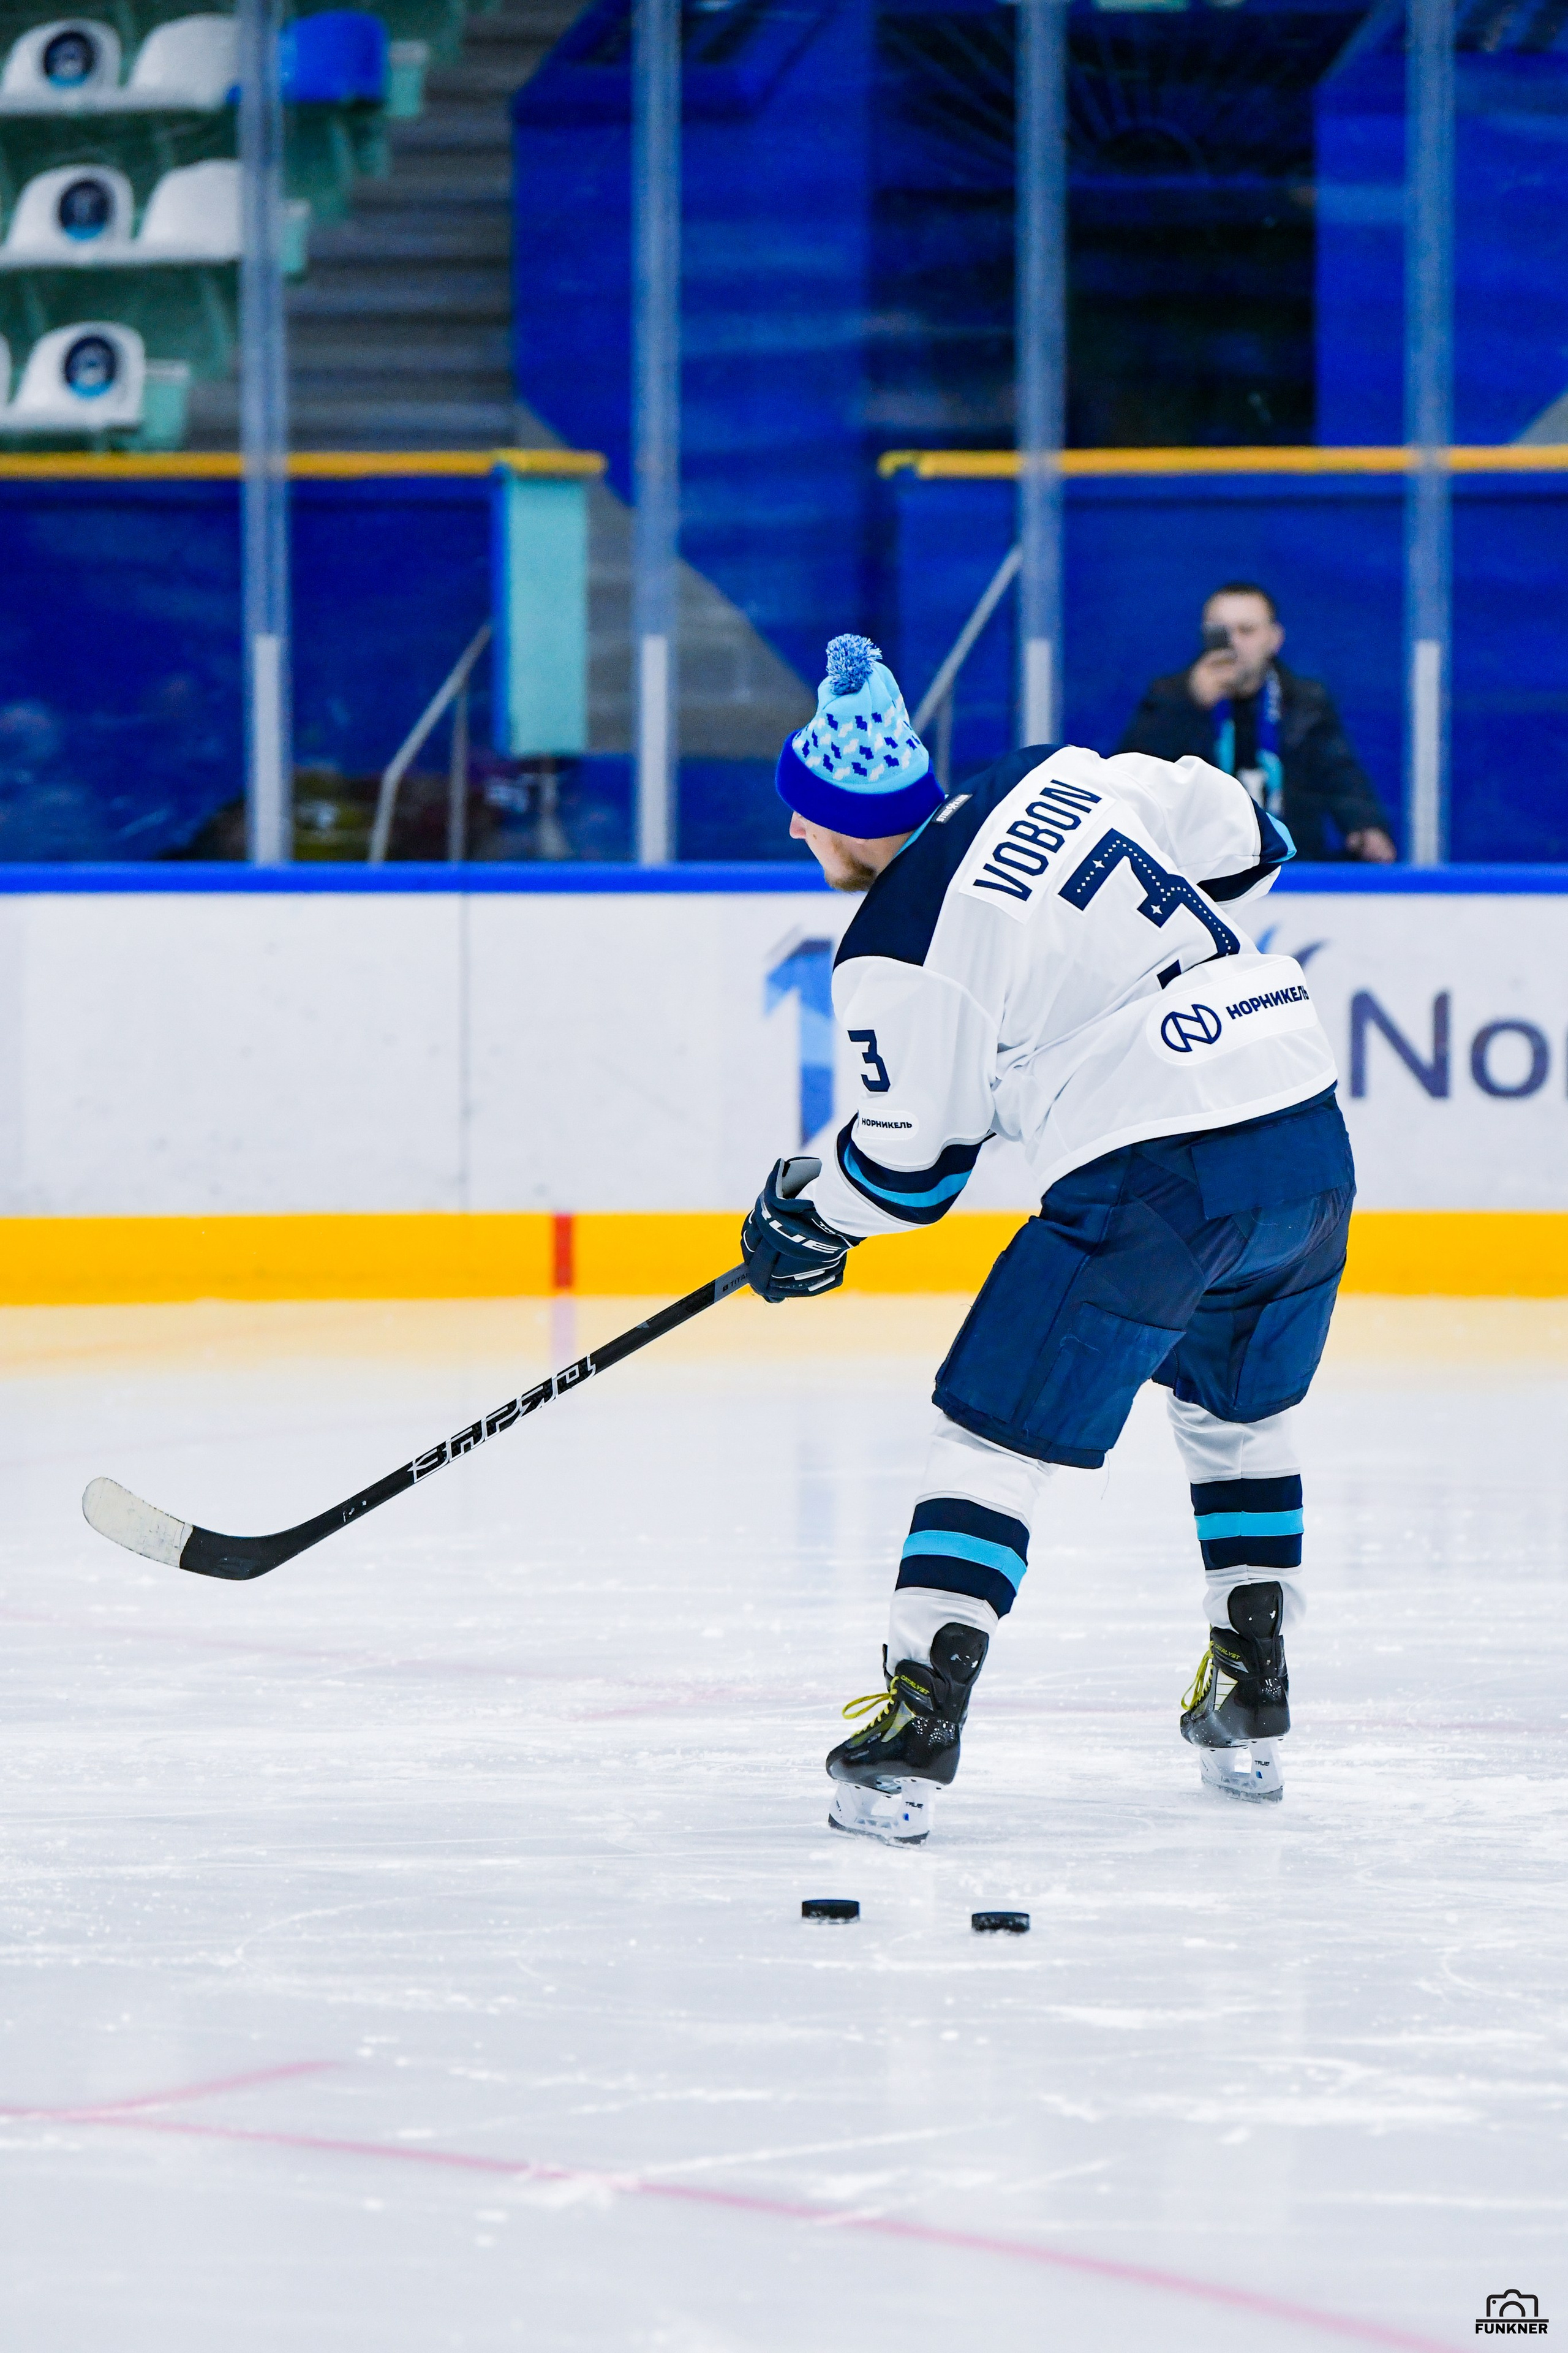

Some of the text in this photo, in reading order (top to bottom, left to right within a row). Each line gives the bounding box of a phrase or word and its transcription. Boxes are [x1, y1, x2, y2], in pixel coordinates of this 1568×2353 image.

[972, 779, 1102, 902] VOBON
[1057, 827, 1241, 990] 3
[1226, 985, 1310, 1020] НОРНИКЕЛЬ
[847, 1029, 891, 1092] 3
[1349, 987, 1568, 1101] No
[861, 1117, 913, 1129] НОРНИКЕЛЬ
[759, 1192, 842, 1254] RUE
[1215, 1644, 1241, 1660] CATALYST
[900, 1674, 930, 1695] CATALYST
[905, 1801, 924, 1810] TRUE
